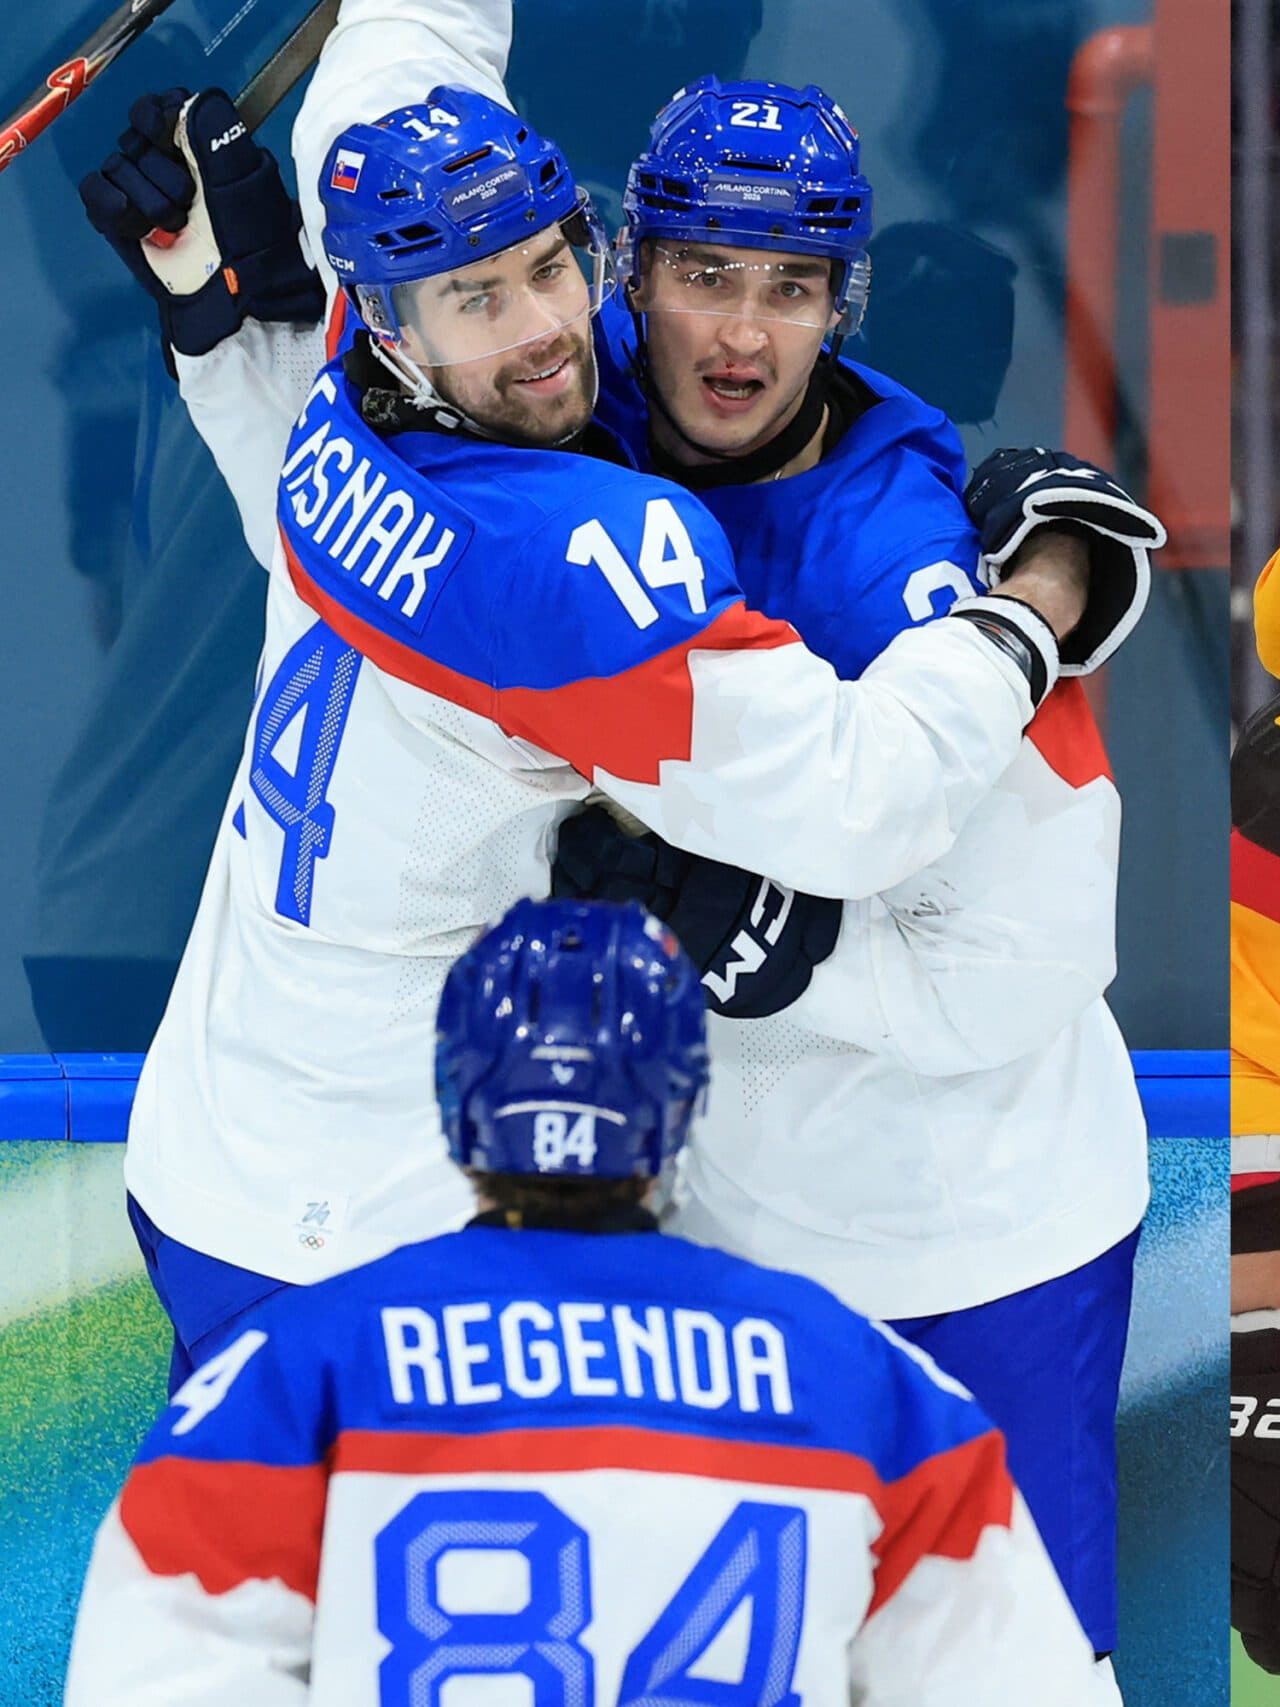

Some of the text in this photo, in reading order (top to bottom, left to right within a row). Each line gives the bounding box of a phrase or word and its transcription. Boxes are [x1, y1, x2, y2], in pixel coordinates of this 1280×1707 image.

[402, 107, 461, 142] 14
[730, 101, 783, 131] 21
[211, 121, 248, 152] CM
[452, 170, 517, 205] MILANO CORTINA
[714, 183, 790, 196] MILANO CORTINA
[328, 253, 354, 272] CCM
[565, 498, 707, 630] 14
[533, 1111, 598, 1171] 84
[381, 1301, 794, 1414] REGENDA
[374, 1489, 808, 1707] 84
